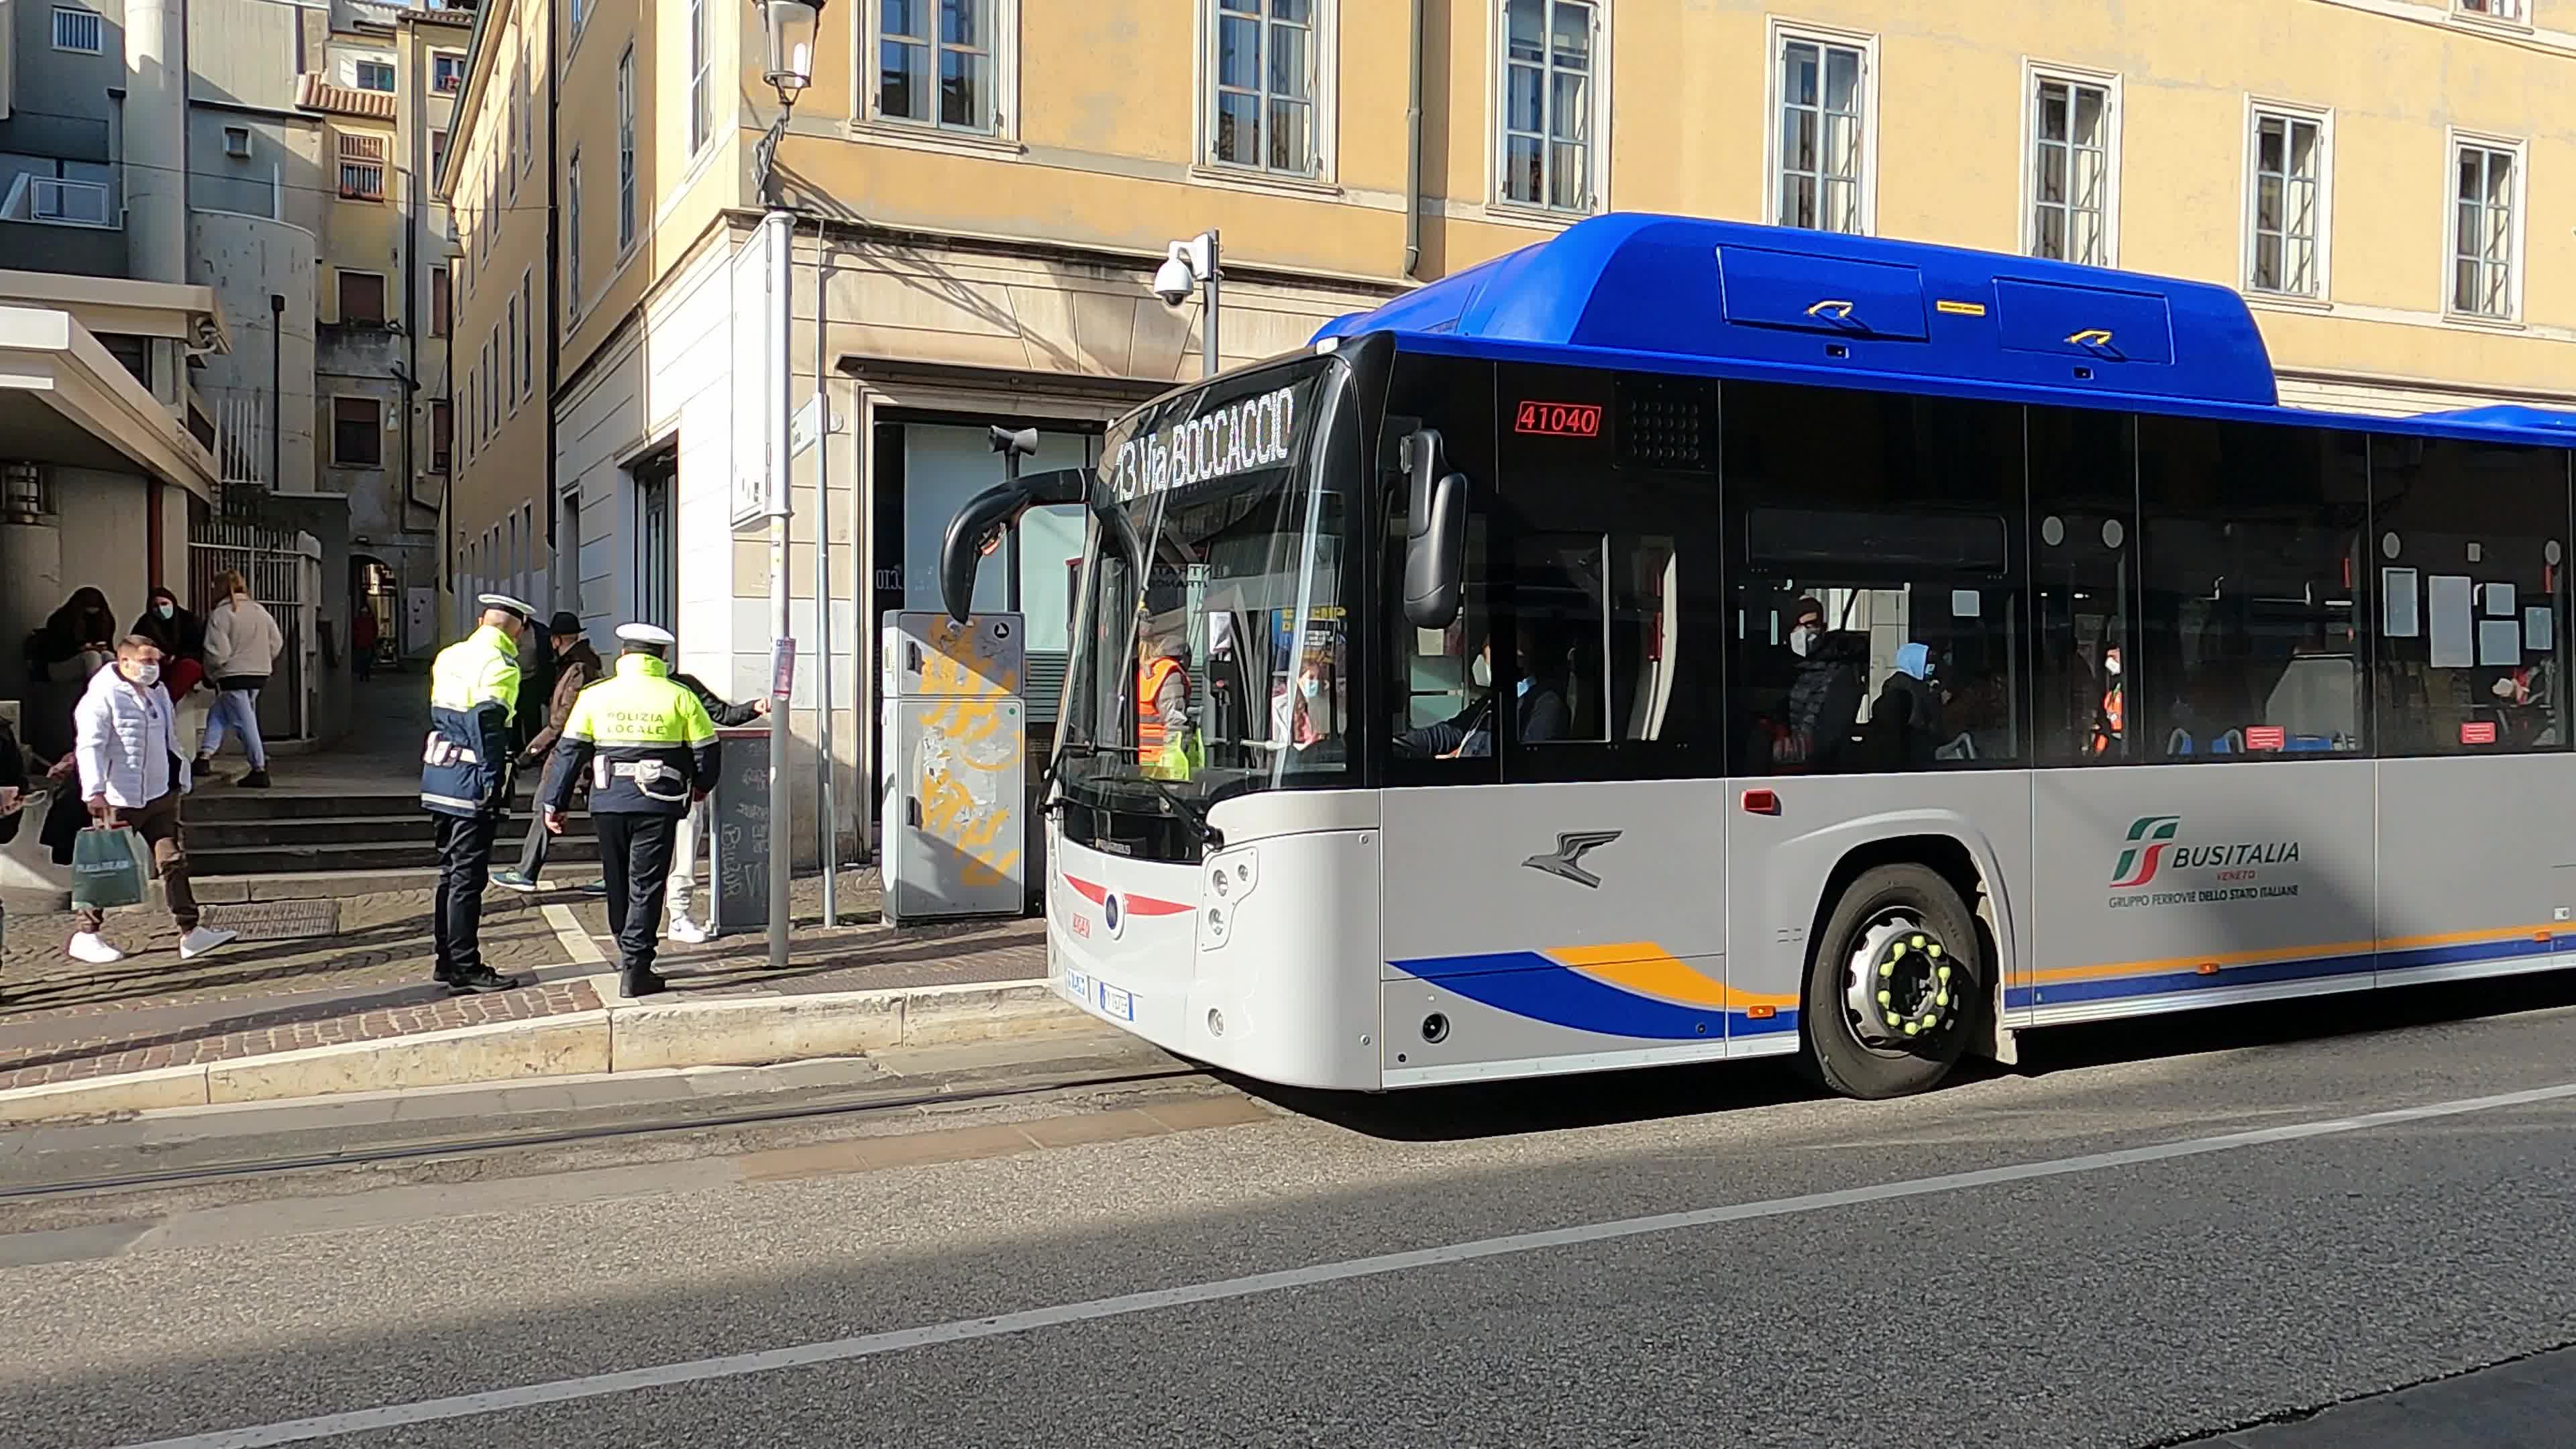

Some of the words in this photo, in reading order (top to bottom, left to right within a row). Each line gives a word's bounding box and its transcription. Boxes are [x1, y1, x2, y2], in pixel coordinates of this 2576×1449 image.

[1520, 405, 1596, 433] 41040
[1140, 432, 1168, 495] Via
[1172, 387, 1293, 488] BOCCACCIO
[606, 712, 664, 723] POLIZIA
[607, 724, 665, 735] LOCALE
[2172, 842, 2300, 869] BUSITALIA
[2216, 870, 2255, 881] VENETO
[2108, 894, 2149, 908] GRUPPO
[2151, 891, 2196, 905] FERROVIE
[2199, 890, 2228, 902] DELLO
[2230, 888, 2258, 900] STATO
